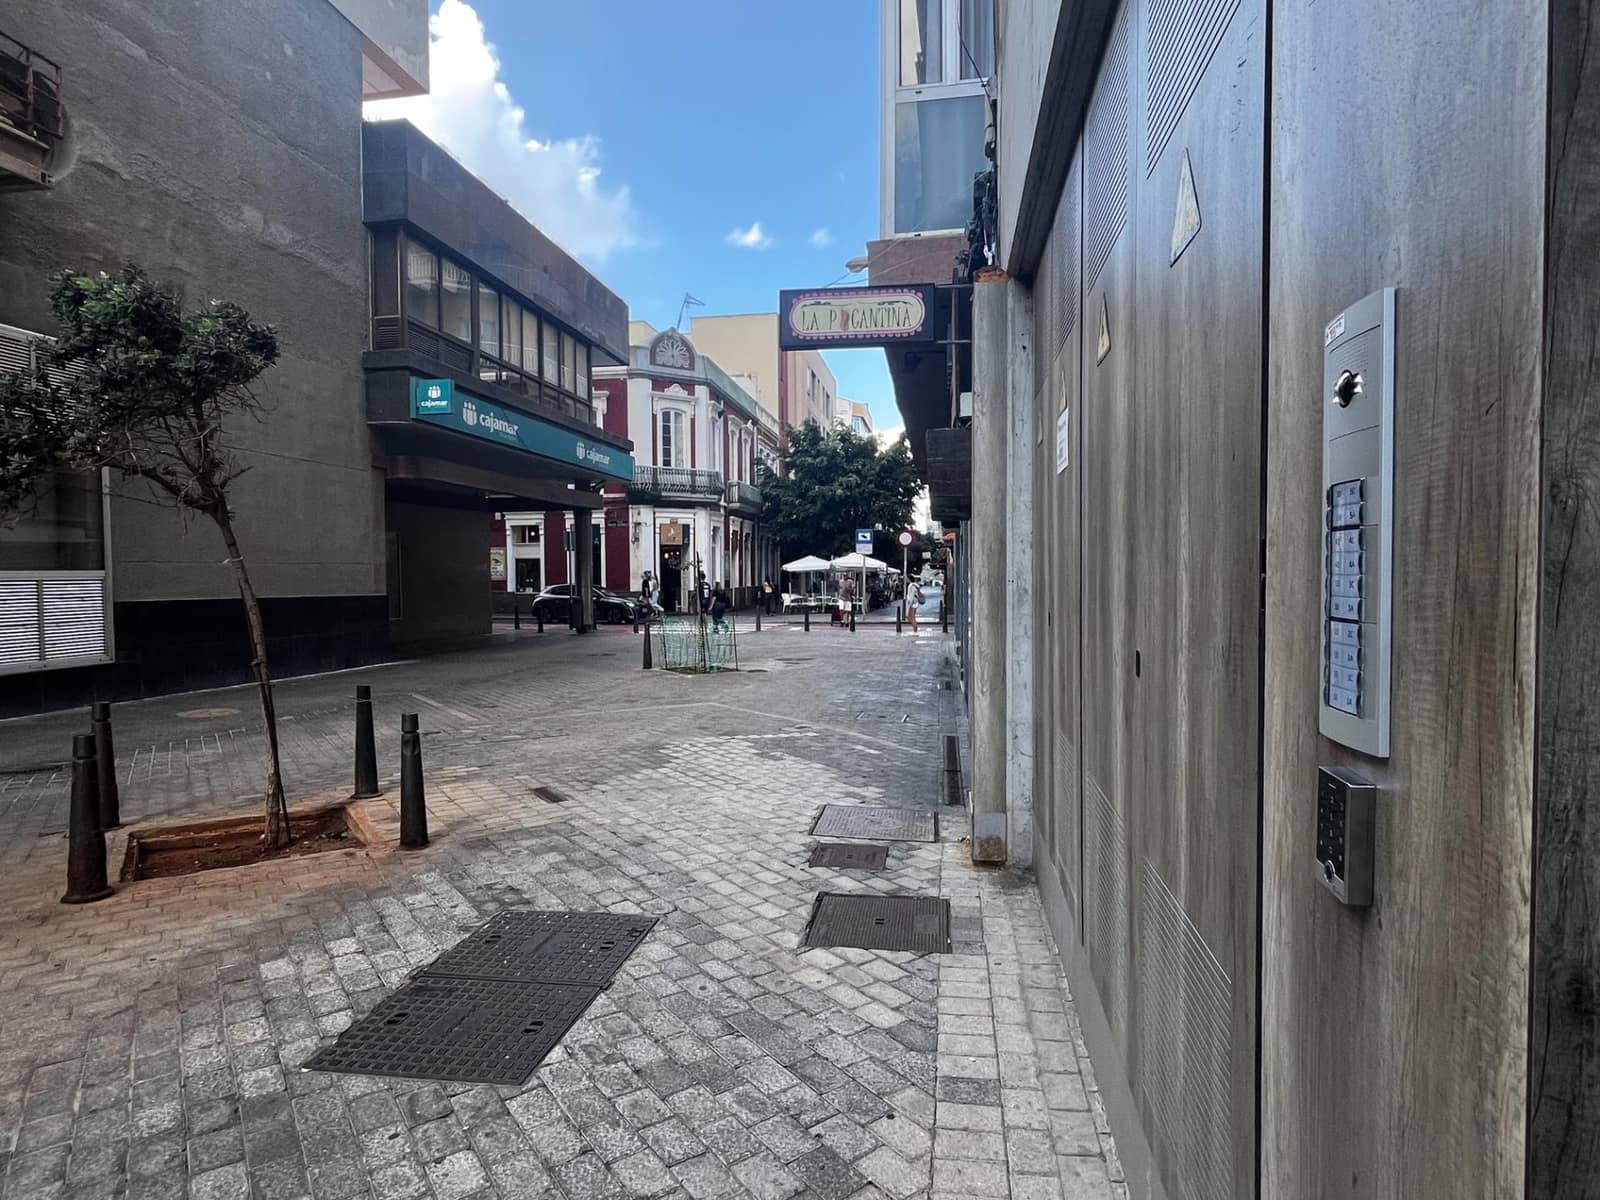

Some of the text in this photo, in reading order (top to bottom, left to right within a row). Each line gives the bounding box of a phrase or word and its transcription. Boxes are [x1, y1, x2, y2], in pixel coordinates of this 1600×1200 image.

[801, 310, 820, 331] LA
[420, 399, 448, 408] cajamar
[479, 411, 519, 435] cajamar
[586, 447, 610, 465] cajamar
